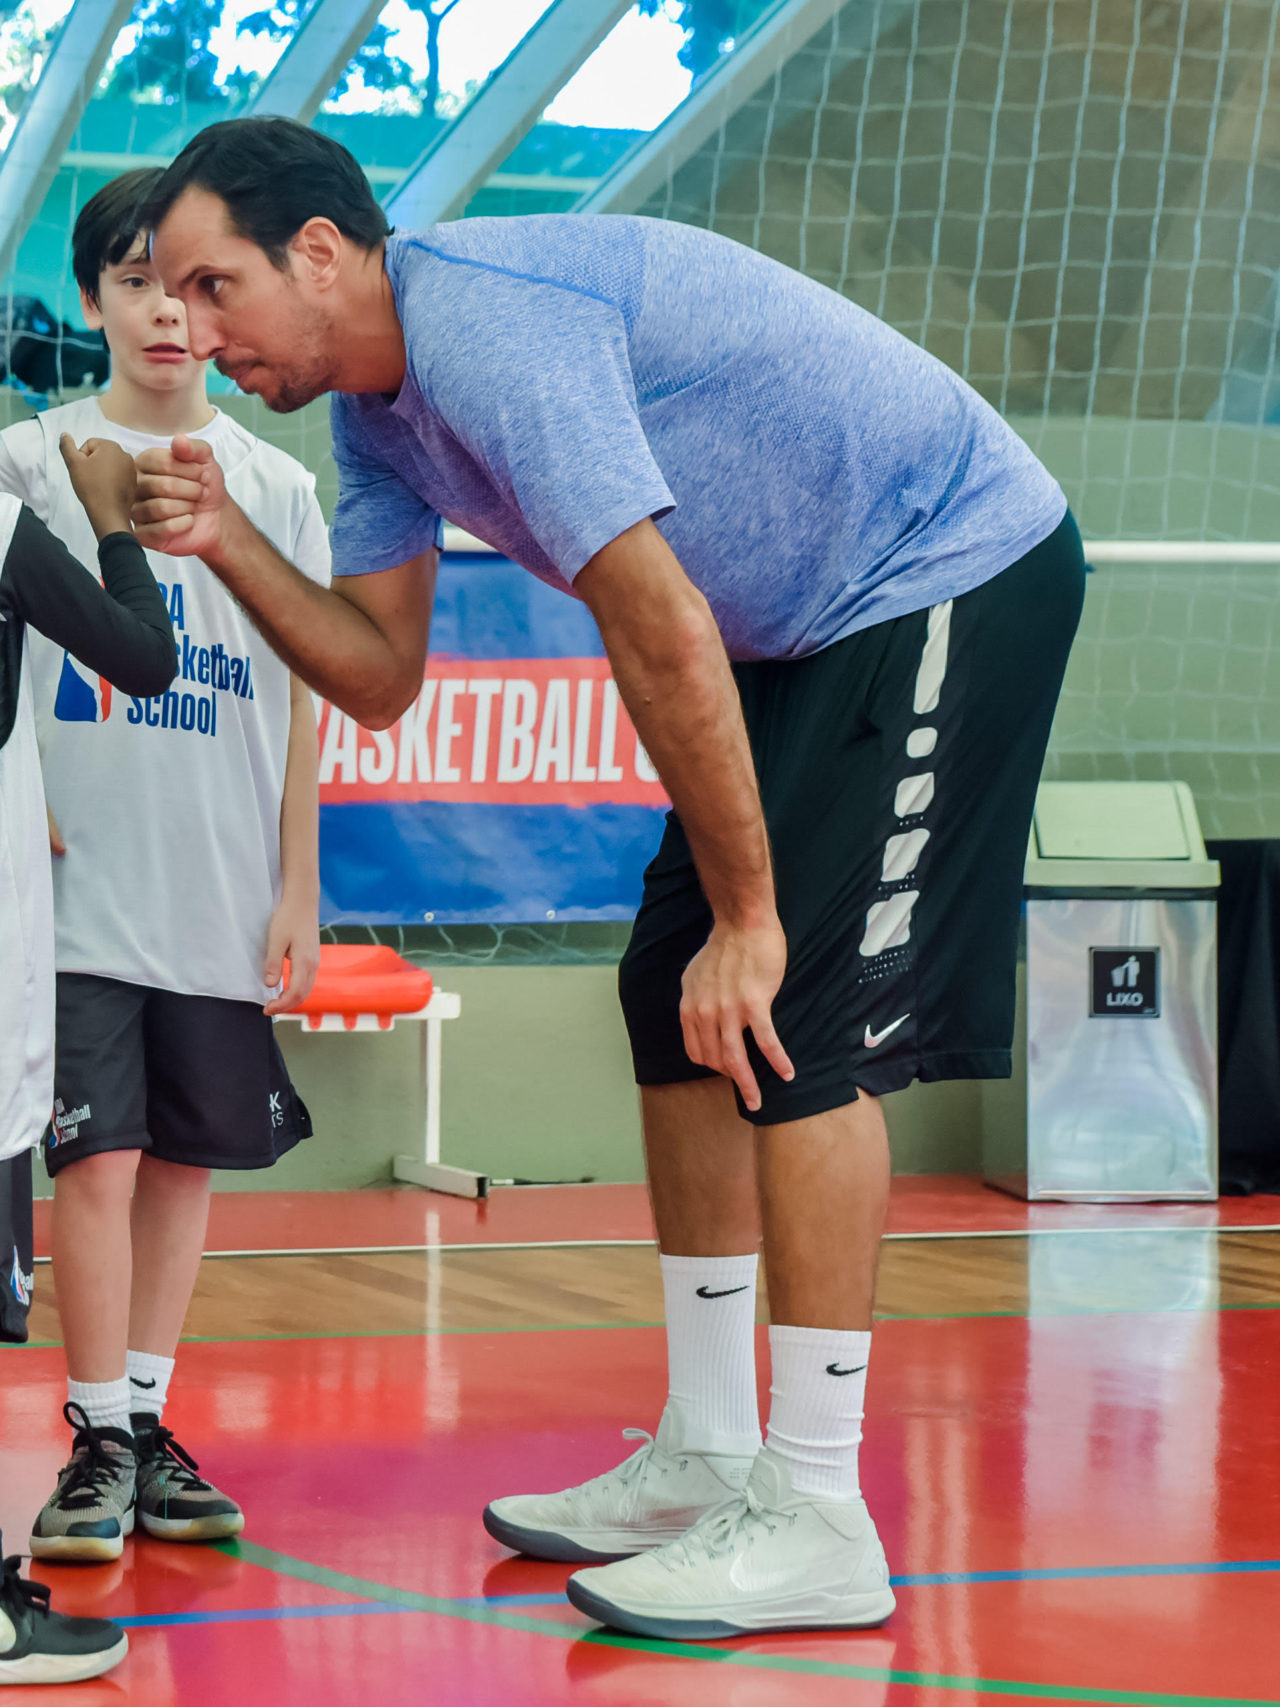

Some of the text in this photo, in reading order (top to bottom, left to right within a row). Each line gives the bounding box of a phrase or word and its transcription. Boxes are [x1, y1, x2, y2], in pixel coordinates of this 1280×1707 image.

[176, 633, 254, 700] ketball
[310, 678, 623, 785] ASKETBALL
[1106, 992, 1144, 1007] LIXO
